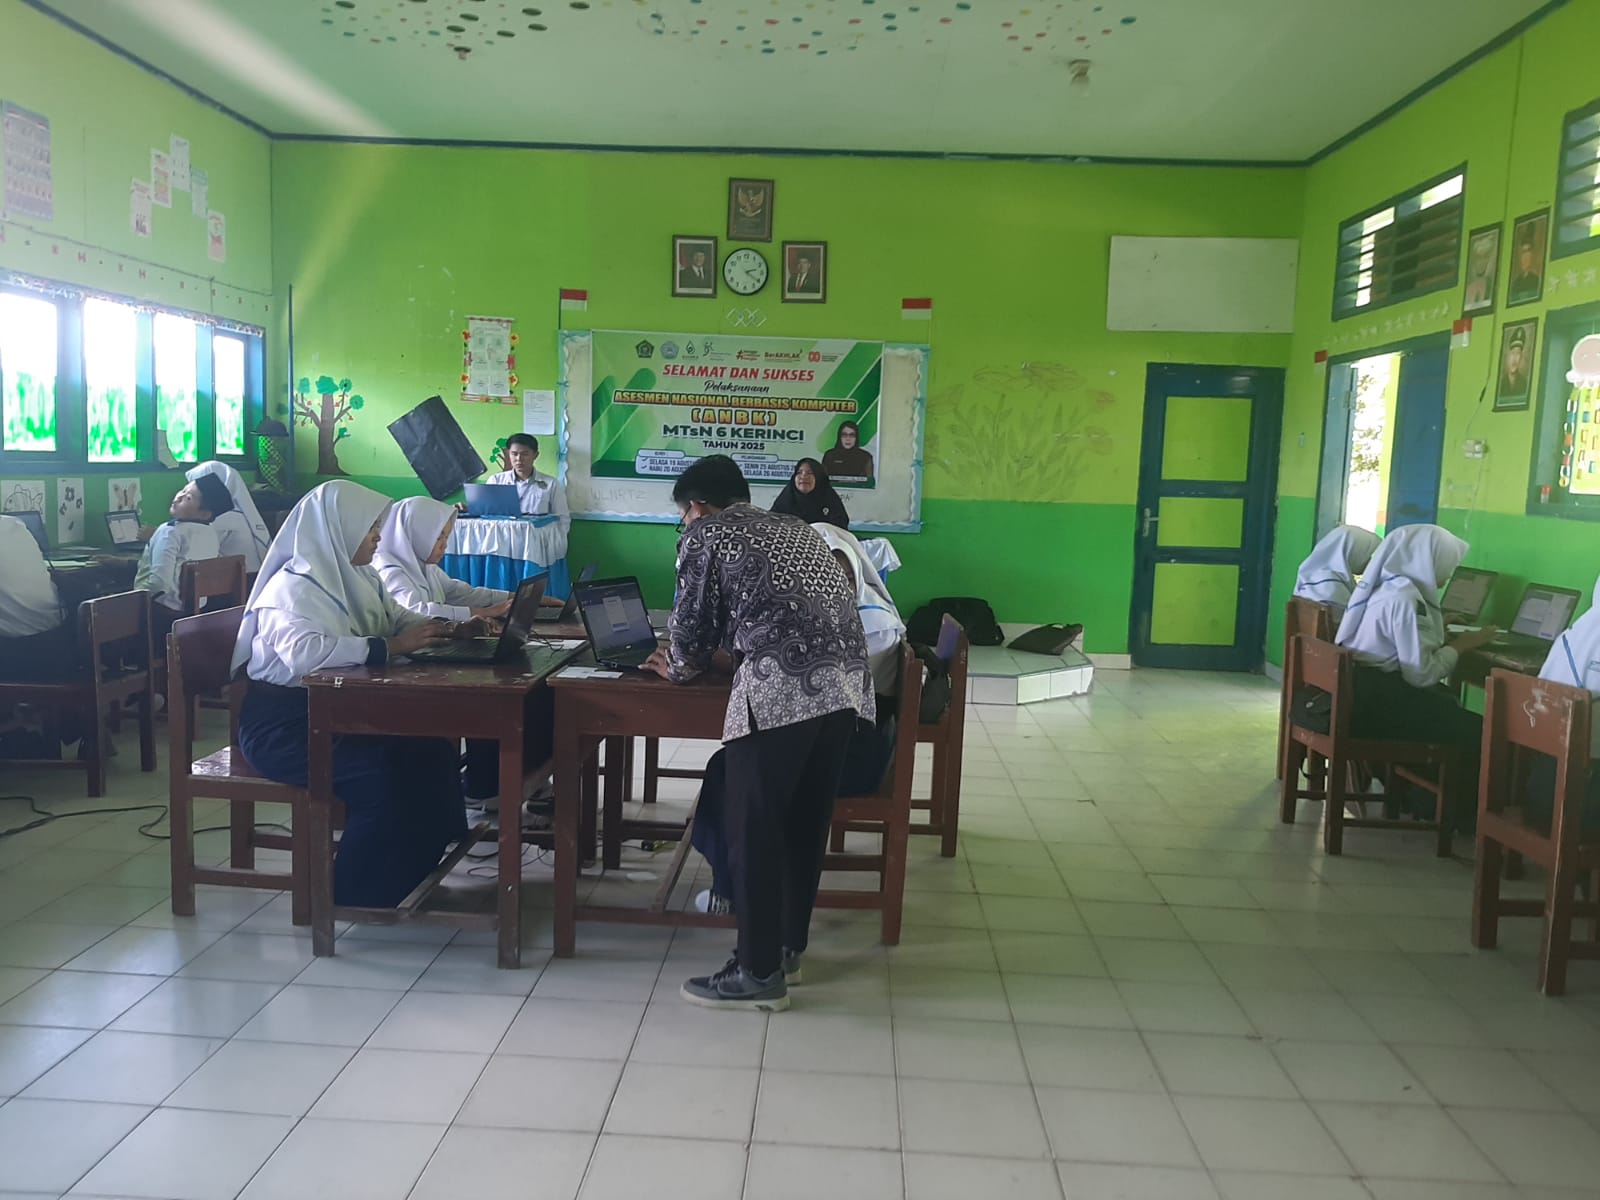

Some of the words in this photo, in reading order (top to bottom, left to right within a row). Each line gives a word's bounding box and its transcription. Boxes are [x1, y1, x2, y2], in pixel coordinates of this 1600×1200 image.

[662, 364, 727, 378] SELAMAT
[729, 366, 759, 379] DAN
[762, 368, 815, 381] SUKSES
[704, 380, 770, 393] Pelaksanaan
[614, 390, 670, 405] ASESMEN
[671, 393, 730, 408] NASIONAL
[730, 396, 790, 410] BERBASIS
[791, 399, 857, 412] KOMPUTER
[663, 424, 712, 437] MTsN
[716, 426, 727, 437] 6
[731, 427, 804, 441] KERINCI
[703, 440, 738, 449] TAHUN
[741, 442, 765, 450] 2025
